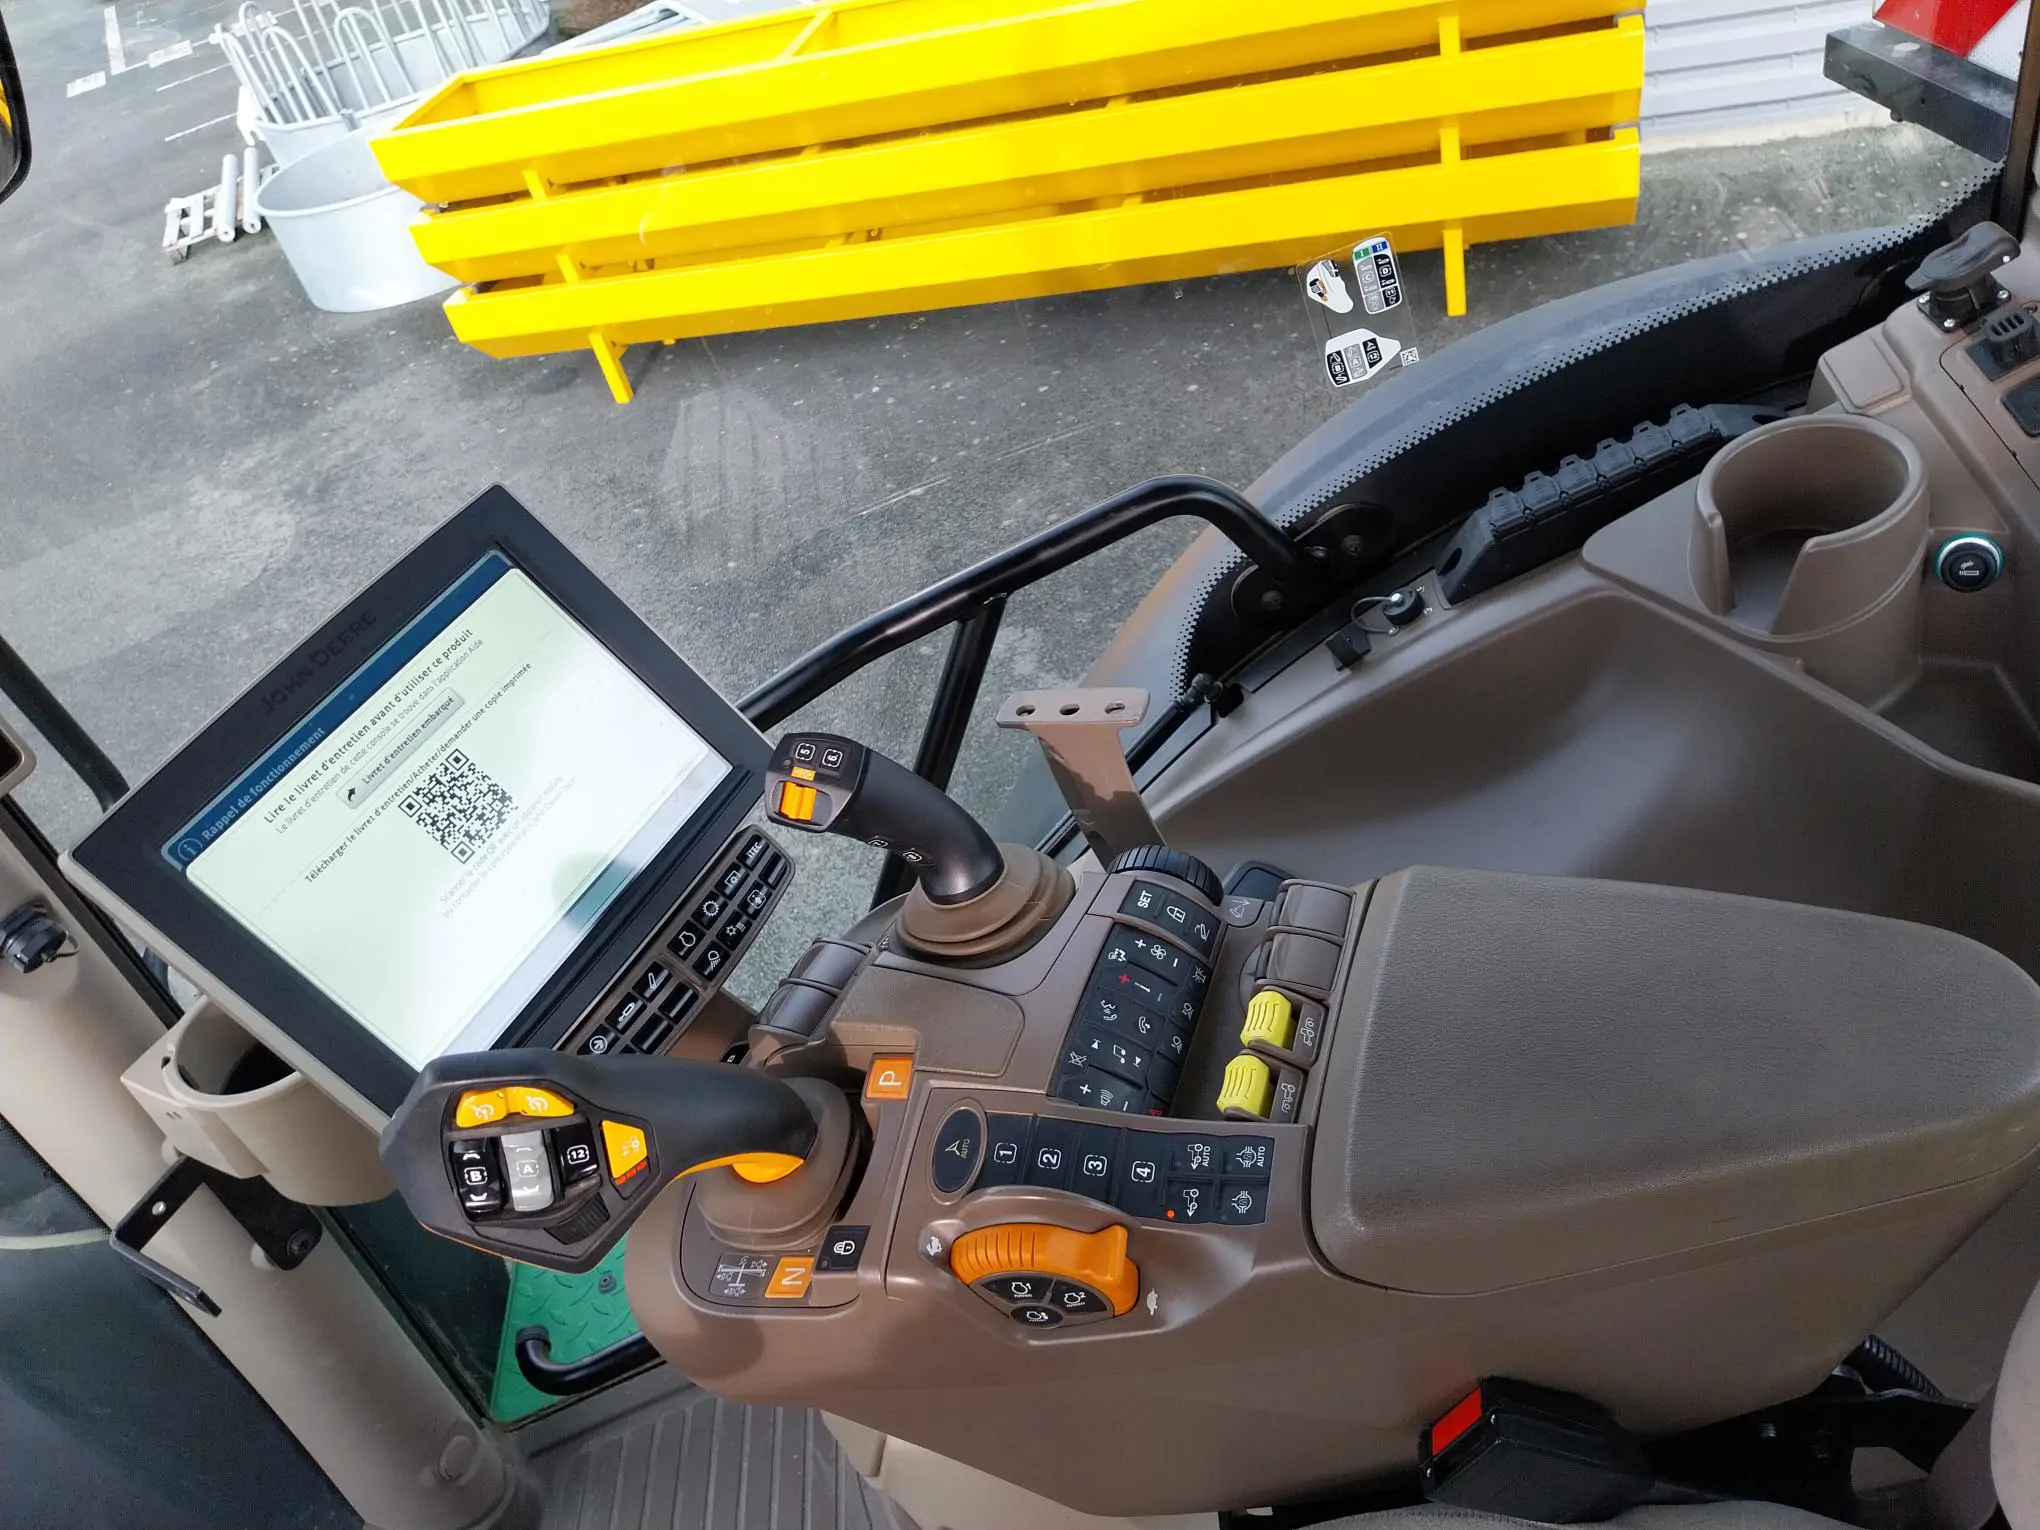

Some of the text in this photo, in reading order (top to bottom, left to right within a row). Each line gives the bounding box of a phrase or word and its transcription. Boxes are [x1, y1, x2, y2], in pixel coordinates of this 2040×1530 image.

[263, 628, 473, 823] Lire le livret d'entretien avant d'utiliser ce produit
[361, 695, 455, 784] Livret d'entretien embarqué
[275, 823, 288, 834] Le
[284, 805, 306, 825] livret
[304, 772, 341, 808] d'entretien
[339, 763, 351, 774] de
[348, 748, 367, 765] cette
[365, 725, 392, 750] console
[389, 717, 400, 727] se
[397, 698, 420, 719] trouve
[417, 685, 435, 700] dans
[304, 841, 348, 882] Télécharger
[345, 833, 356, 843] le
[352, 814, 375, 835] livret
[471, 707, 486, 721] une
[483, 691, 503, 709] copie
[501, 663, 531, 693] imprimée
[200, 727, 325, 840] Rappel de fonctionnement
[1137, 890, 1152, 908] SET
[879, 1071, 902, 1086] P
[570, 1150, 585, 1160] 12
[960, 1139, 970, 1159] AUTO
[1202, 1145, 1211, 1167] AUTO
[1257, 1146, 1265, 1167] AUTO
[1042, 1153, 1057, 1164] 2
[1088, 1160, 1102, 1170] 3
[470, 1170, 482, 1182] B
[523, 1164, 534, 1174] A
[1136, 1166, 1151, 1177] 4
[782, 1268, 806, 1285] N
